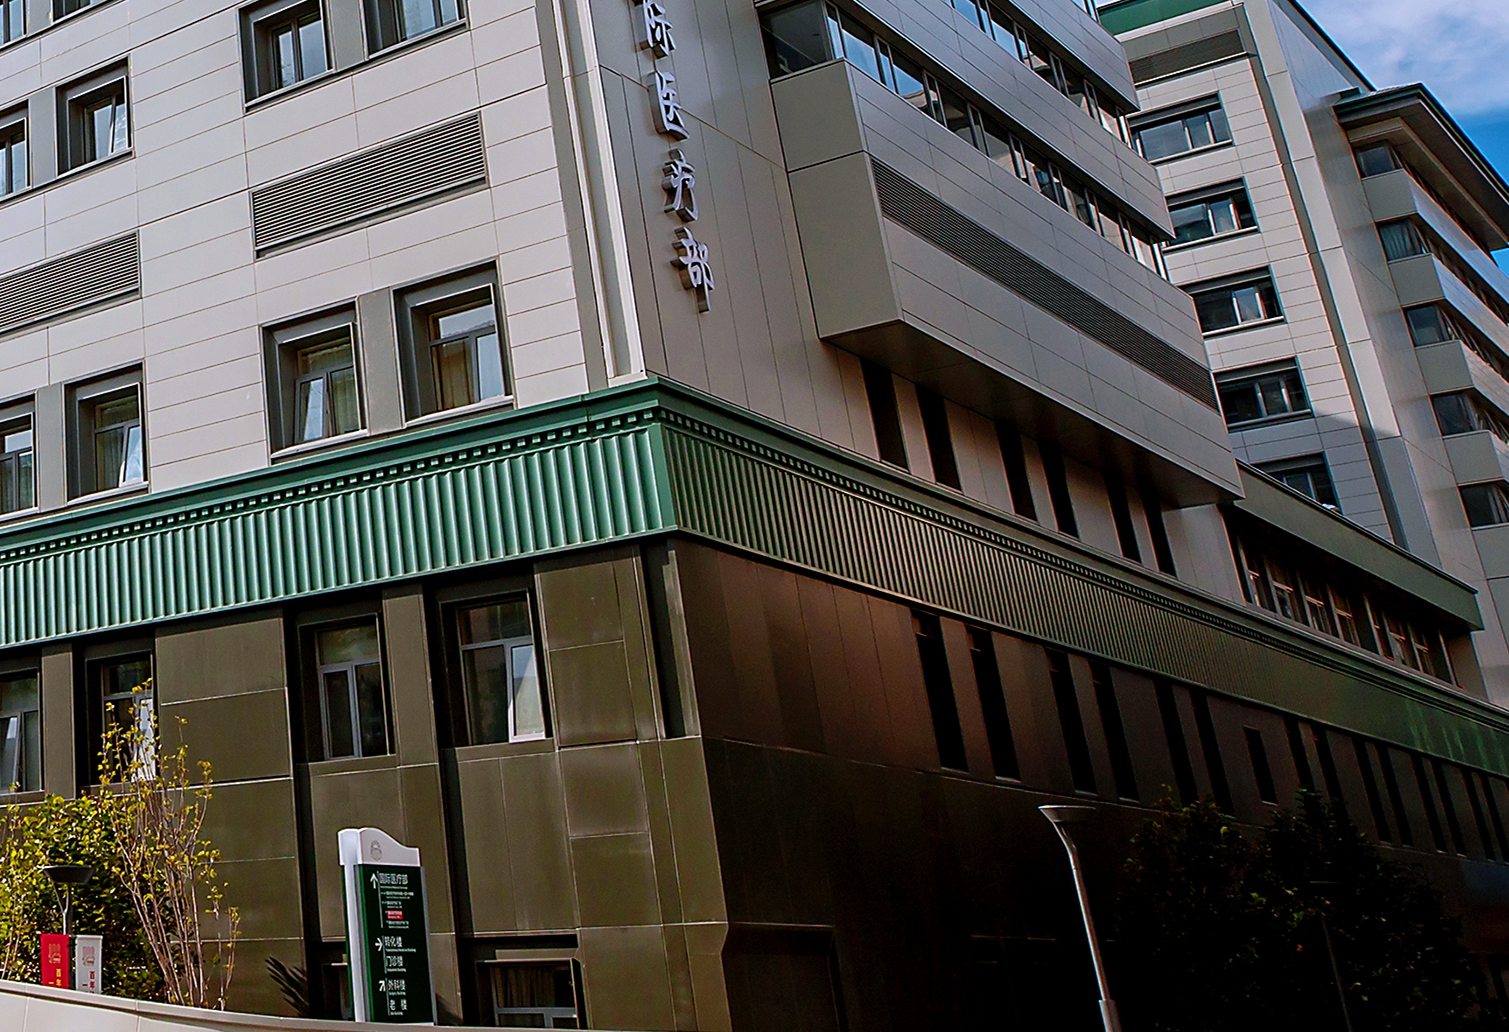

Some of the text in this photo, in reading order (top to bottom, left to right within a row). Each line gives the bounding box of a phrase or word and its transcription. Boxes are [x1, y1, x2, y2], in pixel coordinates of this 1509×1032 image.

[379, 873, 408, 884] 国际医疗部
